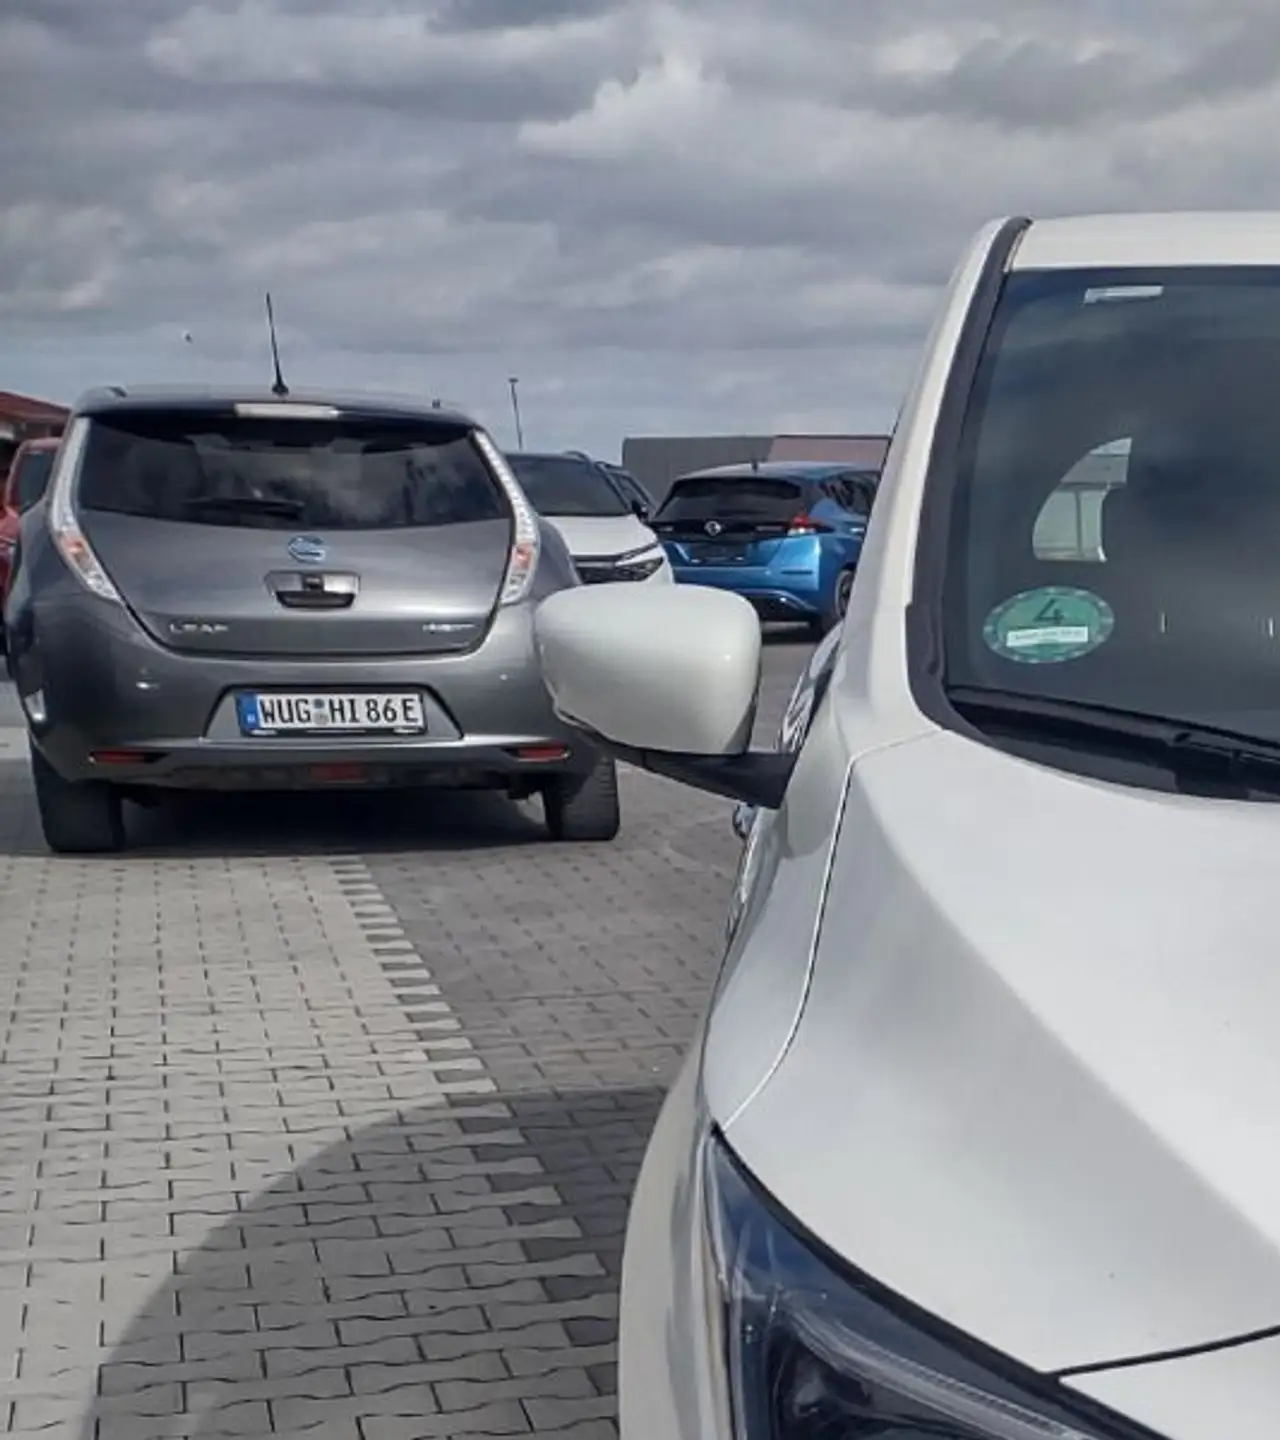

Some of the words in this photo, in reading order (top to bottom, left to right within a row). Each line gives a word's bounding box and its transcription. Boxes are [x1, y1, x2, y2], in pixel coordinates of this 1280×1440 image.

[1033, 598, 1066, 625] 4
[259, 698, 311, 724] WUG
[329, 698, 360, 724] HI
